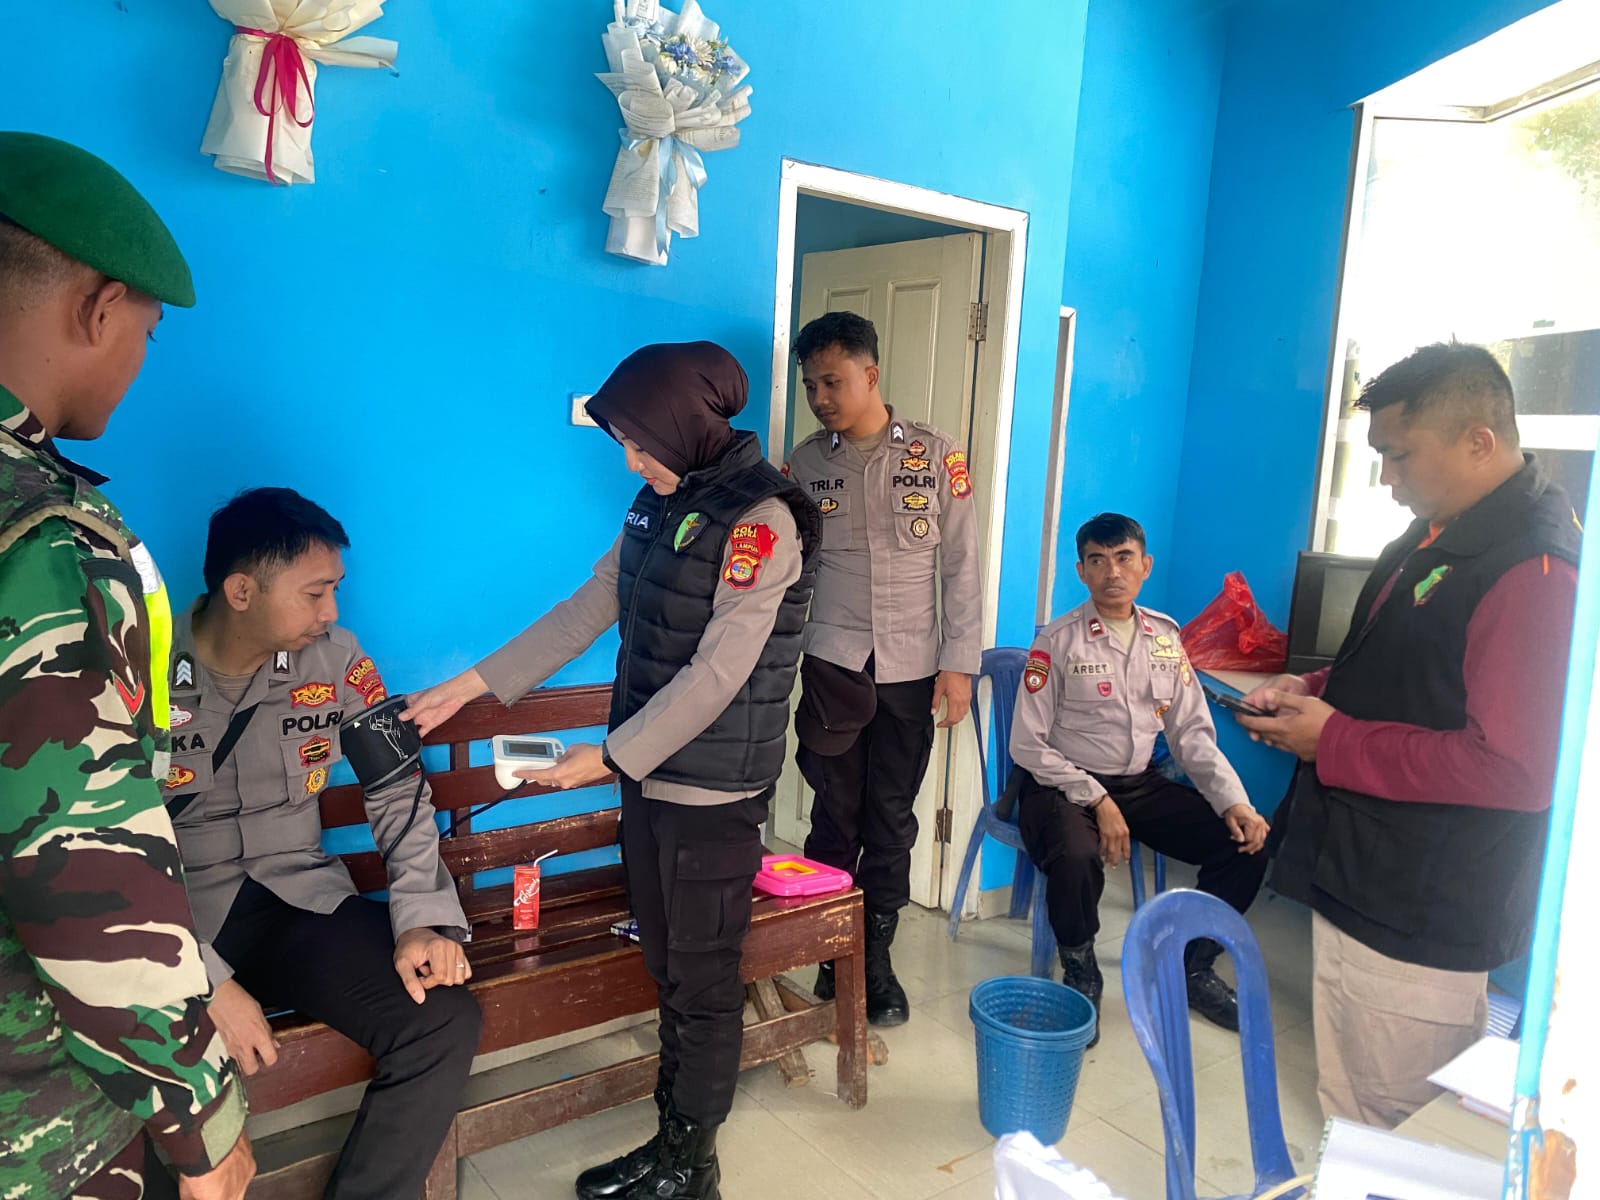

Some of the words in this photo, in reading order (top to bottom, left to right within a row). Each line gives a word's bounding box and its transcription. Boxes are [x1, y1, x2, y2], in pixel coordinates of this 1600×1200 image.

[810, 478, 845, 493] TRI.R
[892, 475, 936, 488] POLRI
[626, 511, 649, 529] RIA
[1073, 663, 1109, 675] ARBET
[282, 709, 344, 736] POLRI
[171, 733, 205, 752] KA
